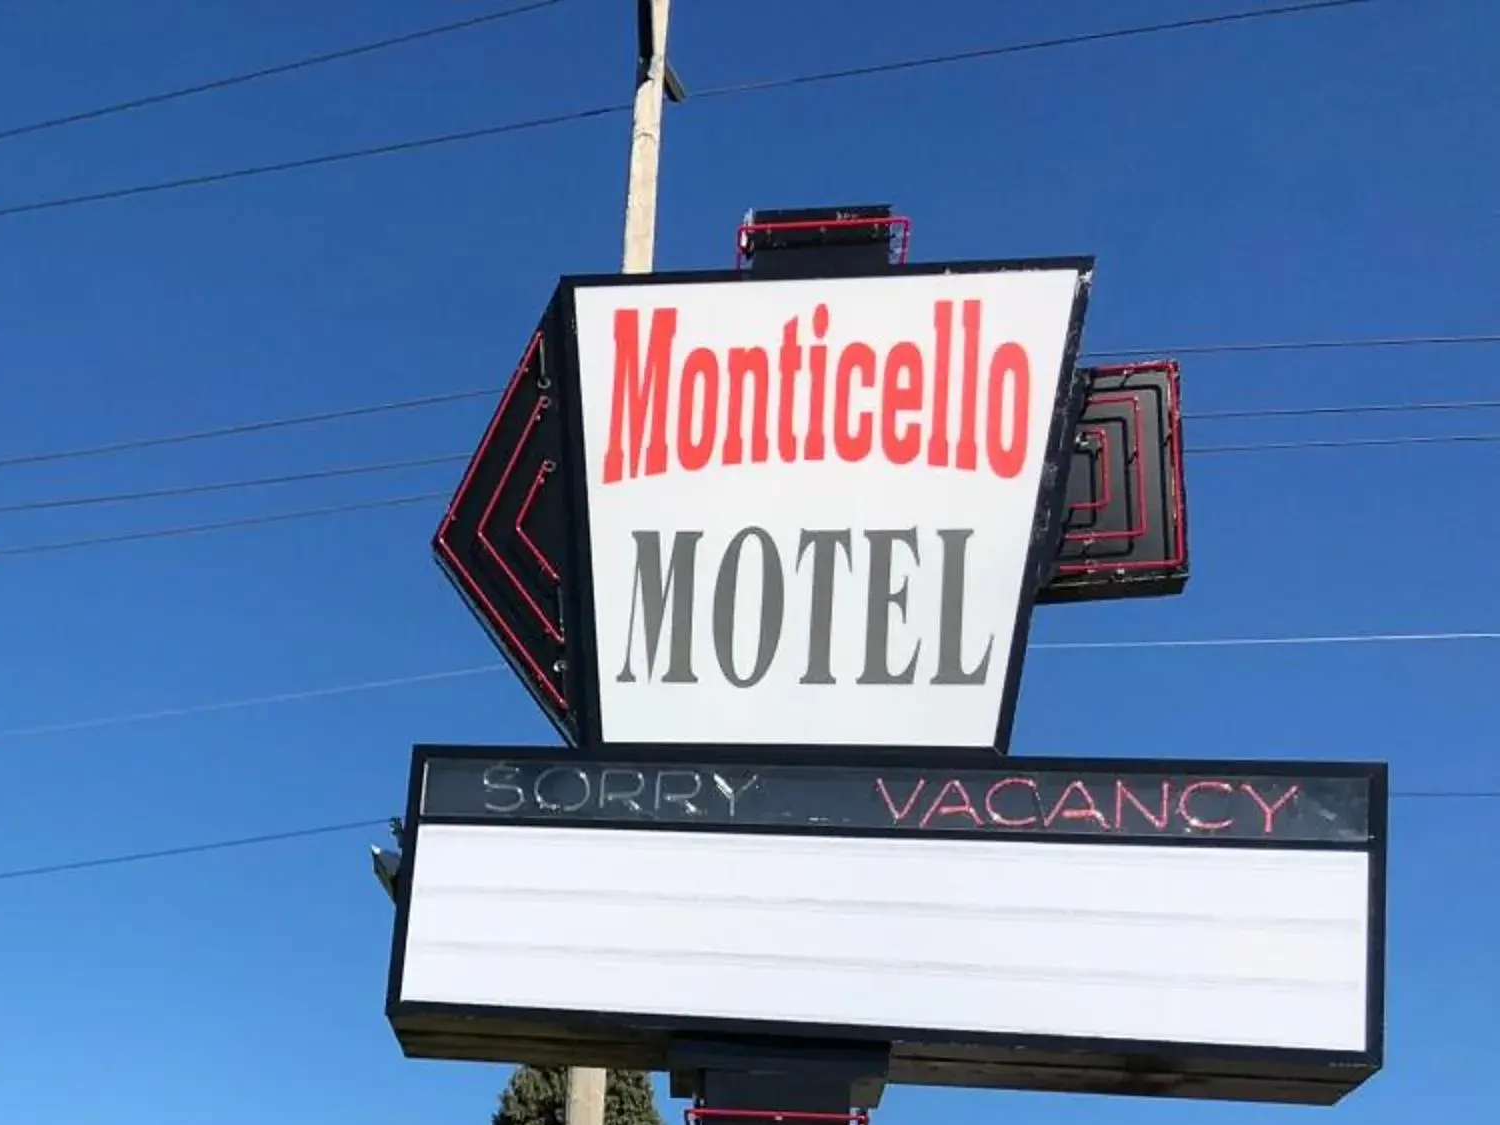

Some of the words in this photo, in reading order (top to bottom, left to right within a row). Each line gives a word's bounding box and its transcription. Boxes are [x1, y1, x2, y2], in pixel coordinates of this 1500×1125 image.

[602, 298, 1032, 485] Monticello
[615, 526, 994, 689] MOTEL
[483, 764, 760, 816] SORRY
[876, 776, 1300, 833] VACANCY
